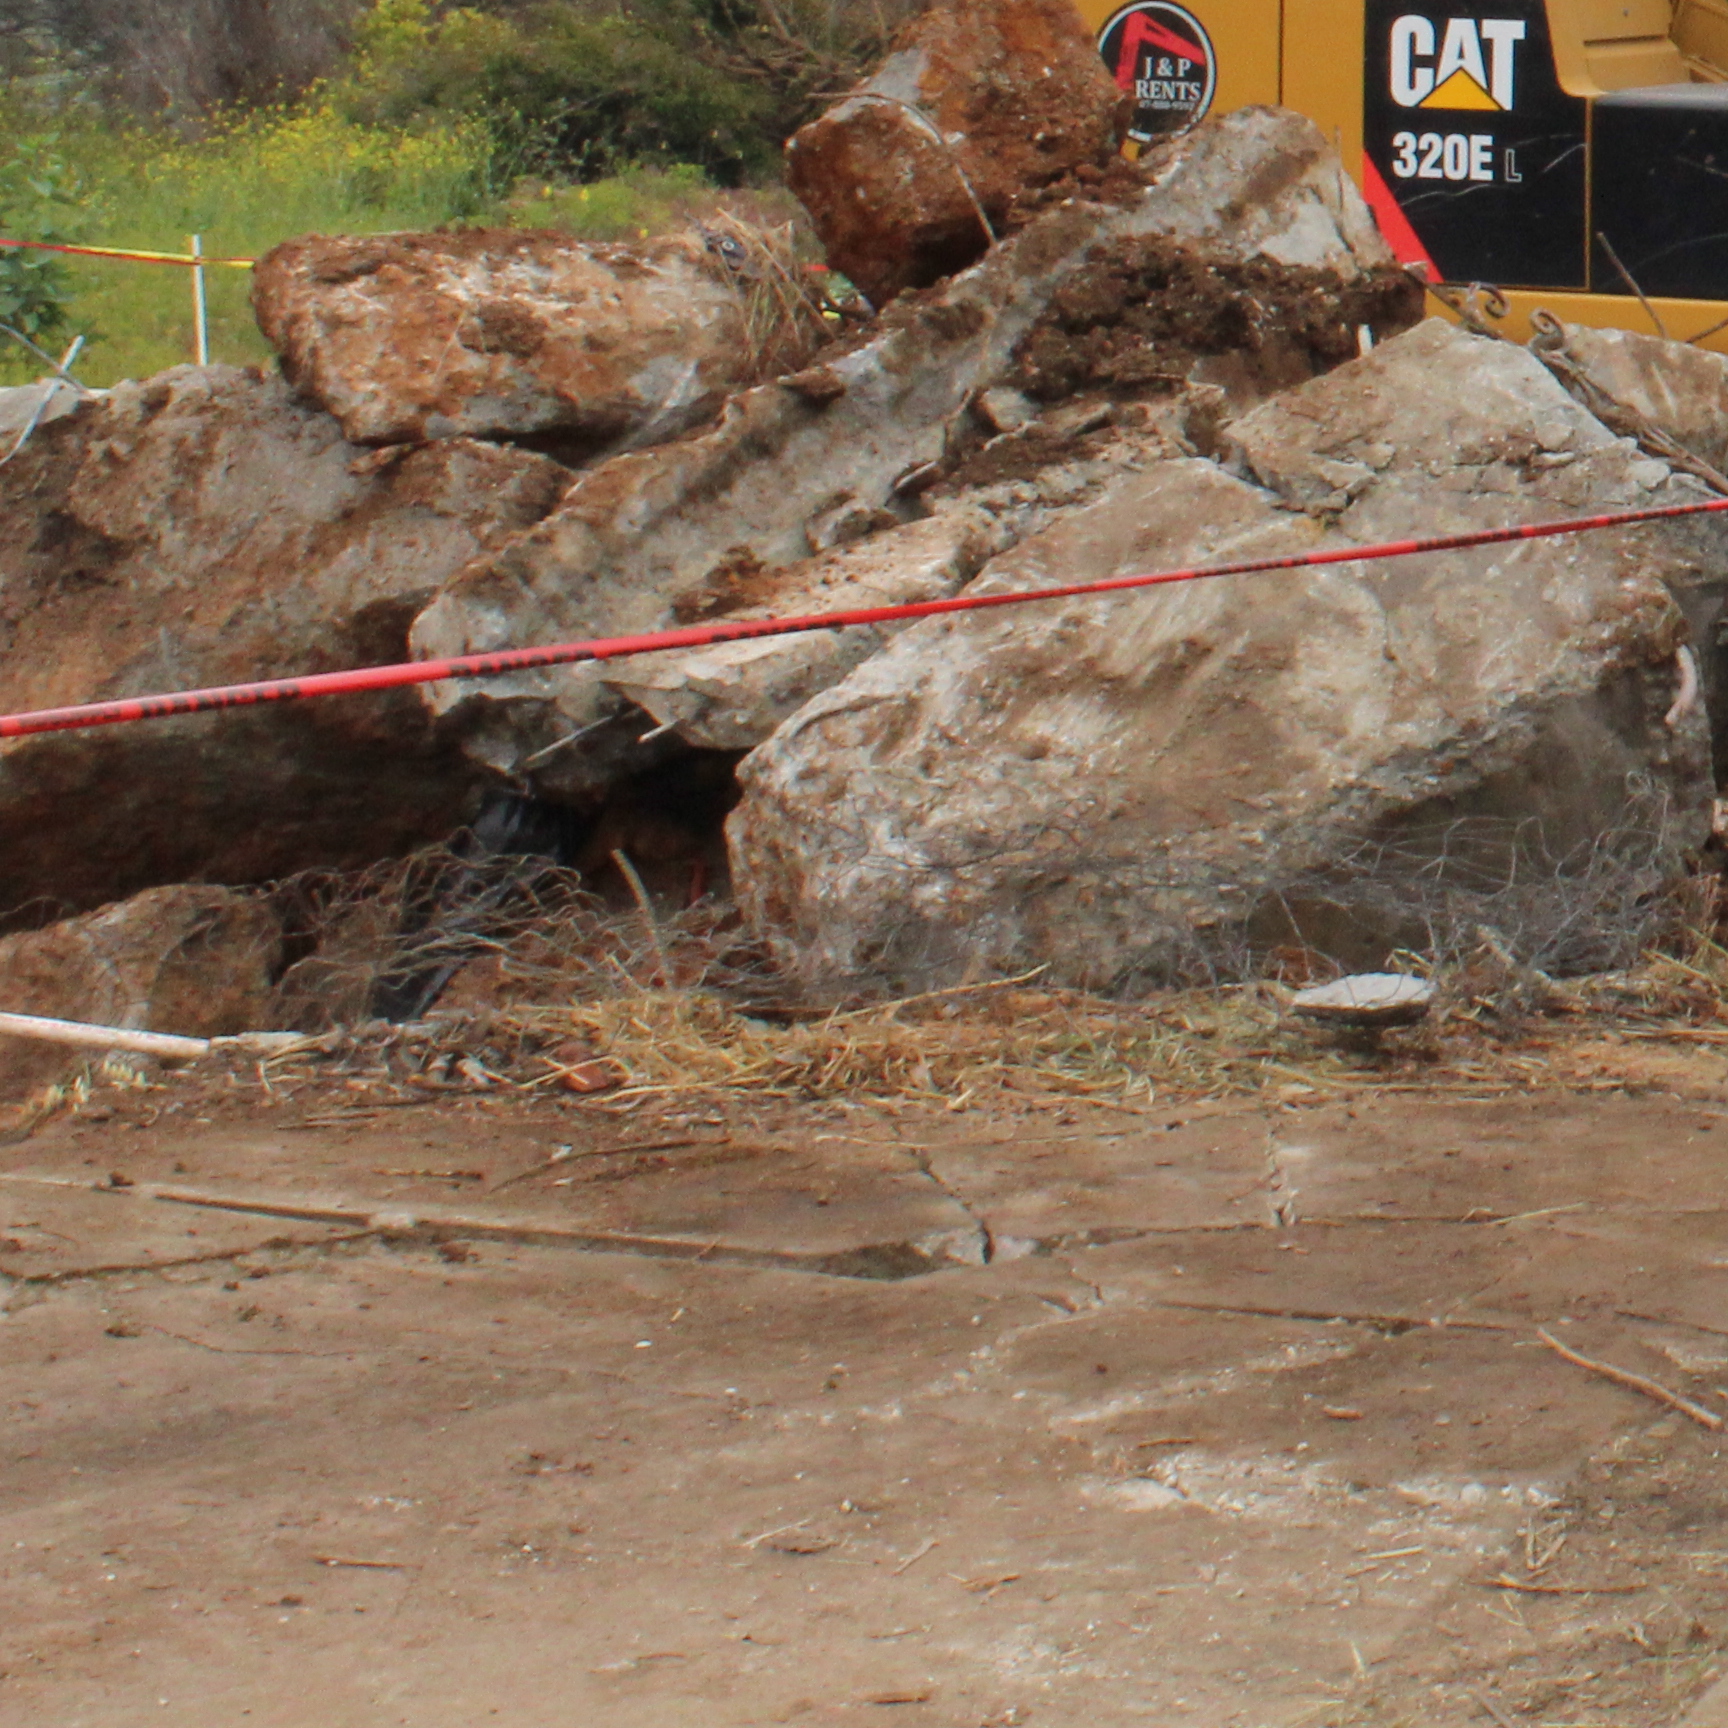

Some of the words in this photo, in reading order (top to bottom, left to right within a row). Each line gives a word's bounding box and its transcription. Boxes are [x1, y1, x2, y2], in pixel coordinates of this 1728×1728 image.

[1143, 56, 1153, 80] J
[1157, 57, 1173, 78] &
[1178, 58, 1192, 78] P
[1391, 15, 1526, 111] CAT
[1135, 80, 1202, 101] RENTS
[1393, 131, 1493, 181] 320E
[1504, 148, 1522, 183] L
